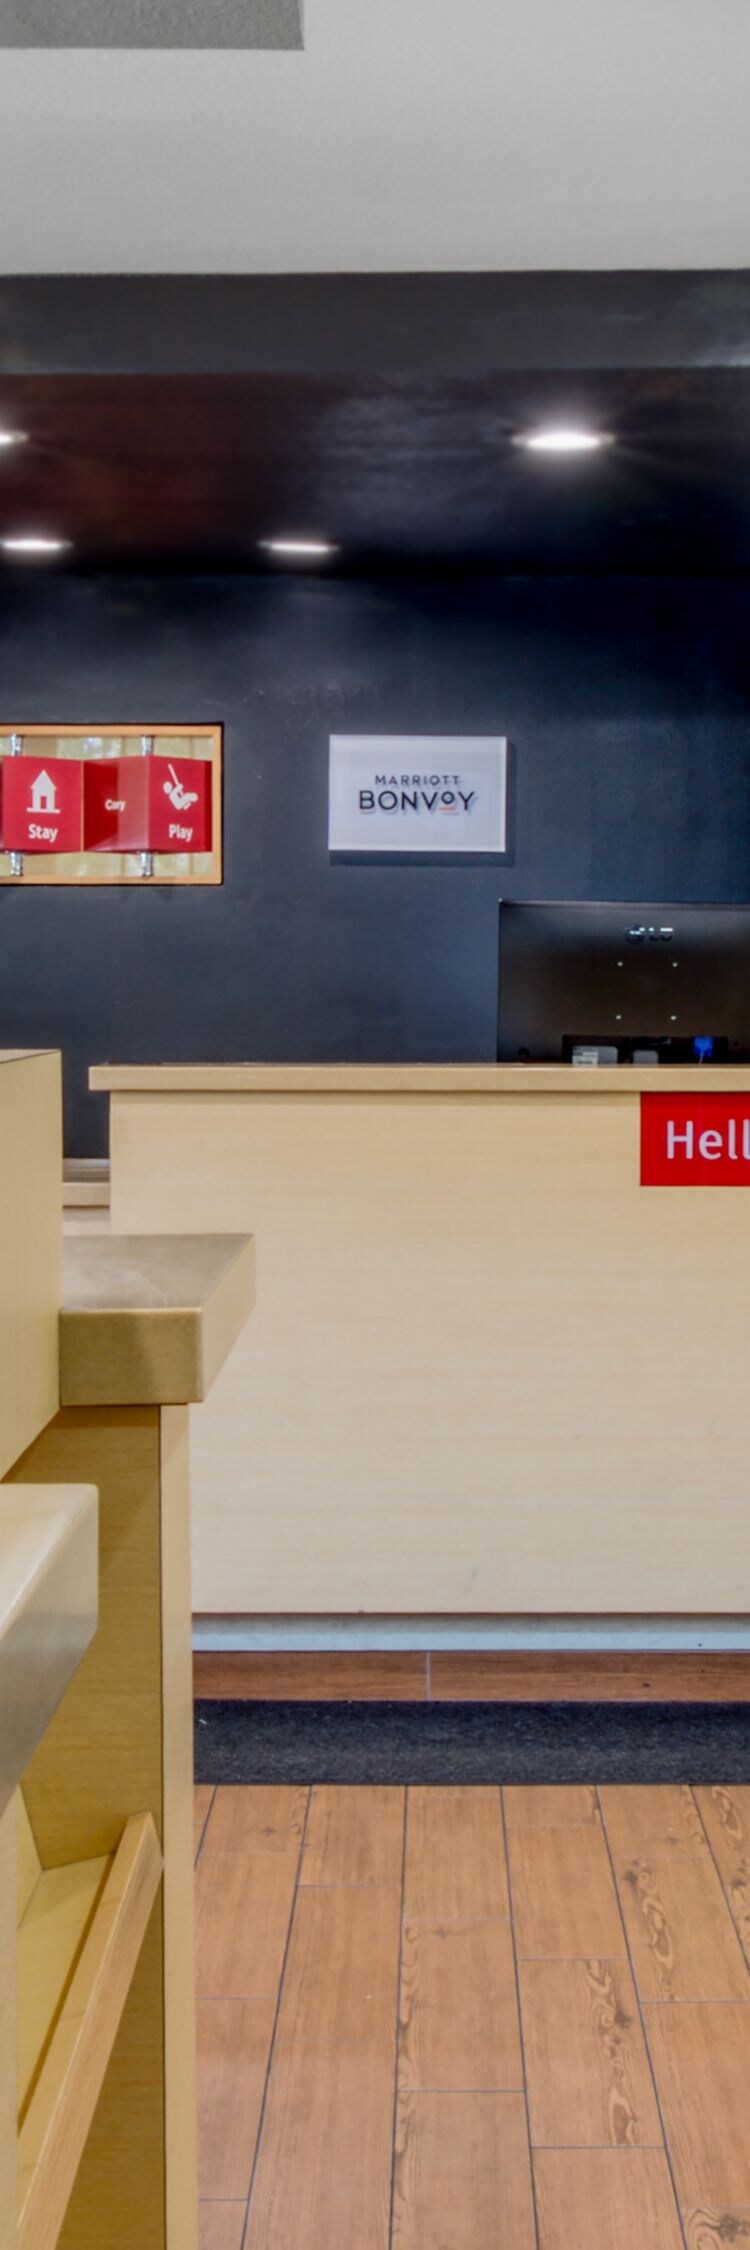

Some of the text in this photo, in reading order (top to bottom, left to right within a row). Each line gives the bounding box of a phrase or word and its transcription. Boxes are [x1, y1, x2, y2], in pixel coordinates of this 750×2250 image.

[375, 775, 461, 786] MARRIOTT
[359, 790, 475, 811] BONVOY
[28, 824, 58, 842] Stay
[168, 824, 193, 842] Play
[666, 1119, 750, 1160] Hell
